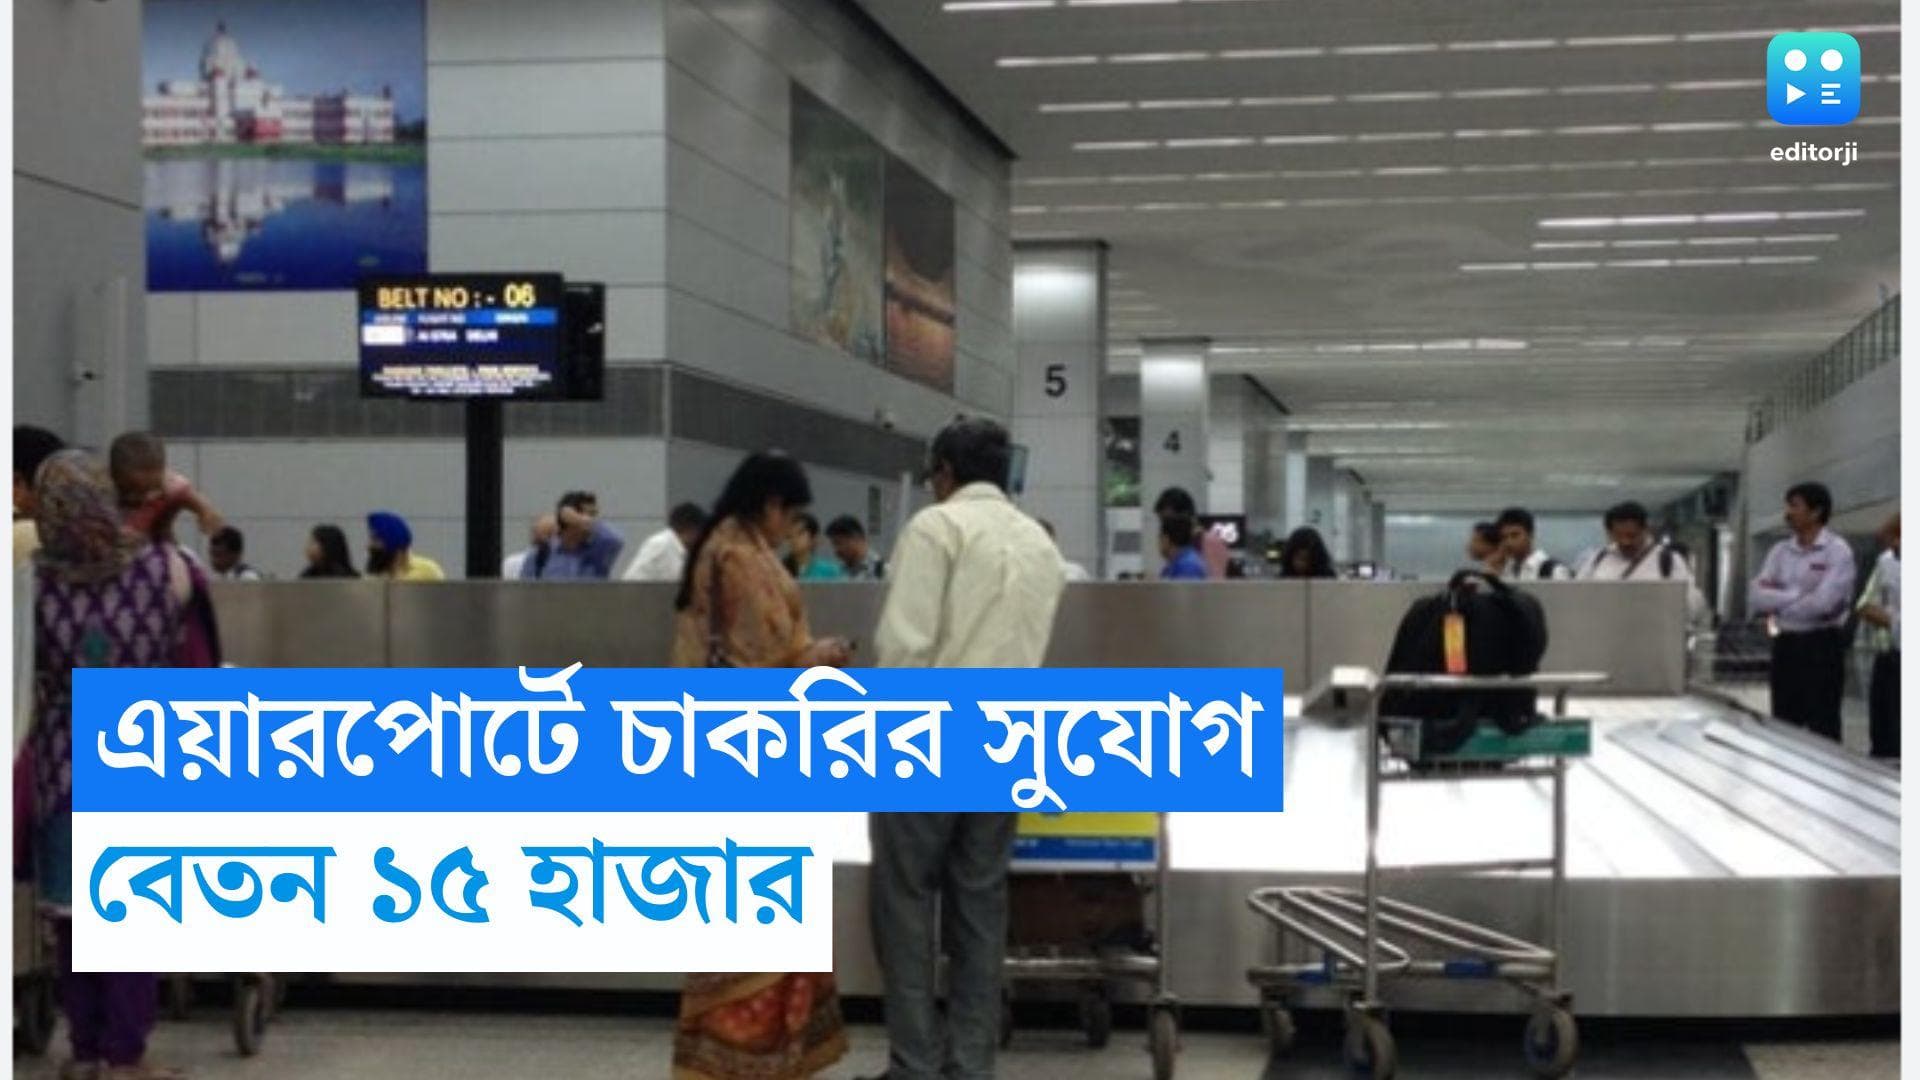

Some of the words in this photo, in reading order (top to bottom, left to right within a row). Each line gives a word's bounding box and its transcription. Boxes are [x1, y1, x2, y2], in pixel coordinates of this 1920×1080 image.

[377, 287, 428, 309] BELT
[433, 287, 470, 309] NO
[503, 282, 537, 309] 06
[1044, 363, 1068, 398] 5
[1162, 429, 1182, 454] 4
